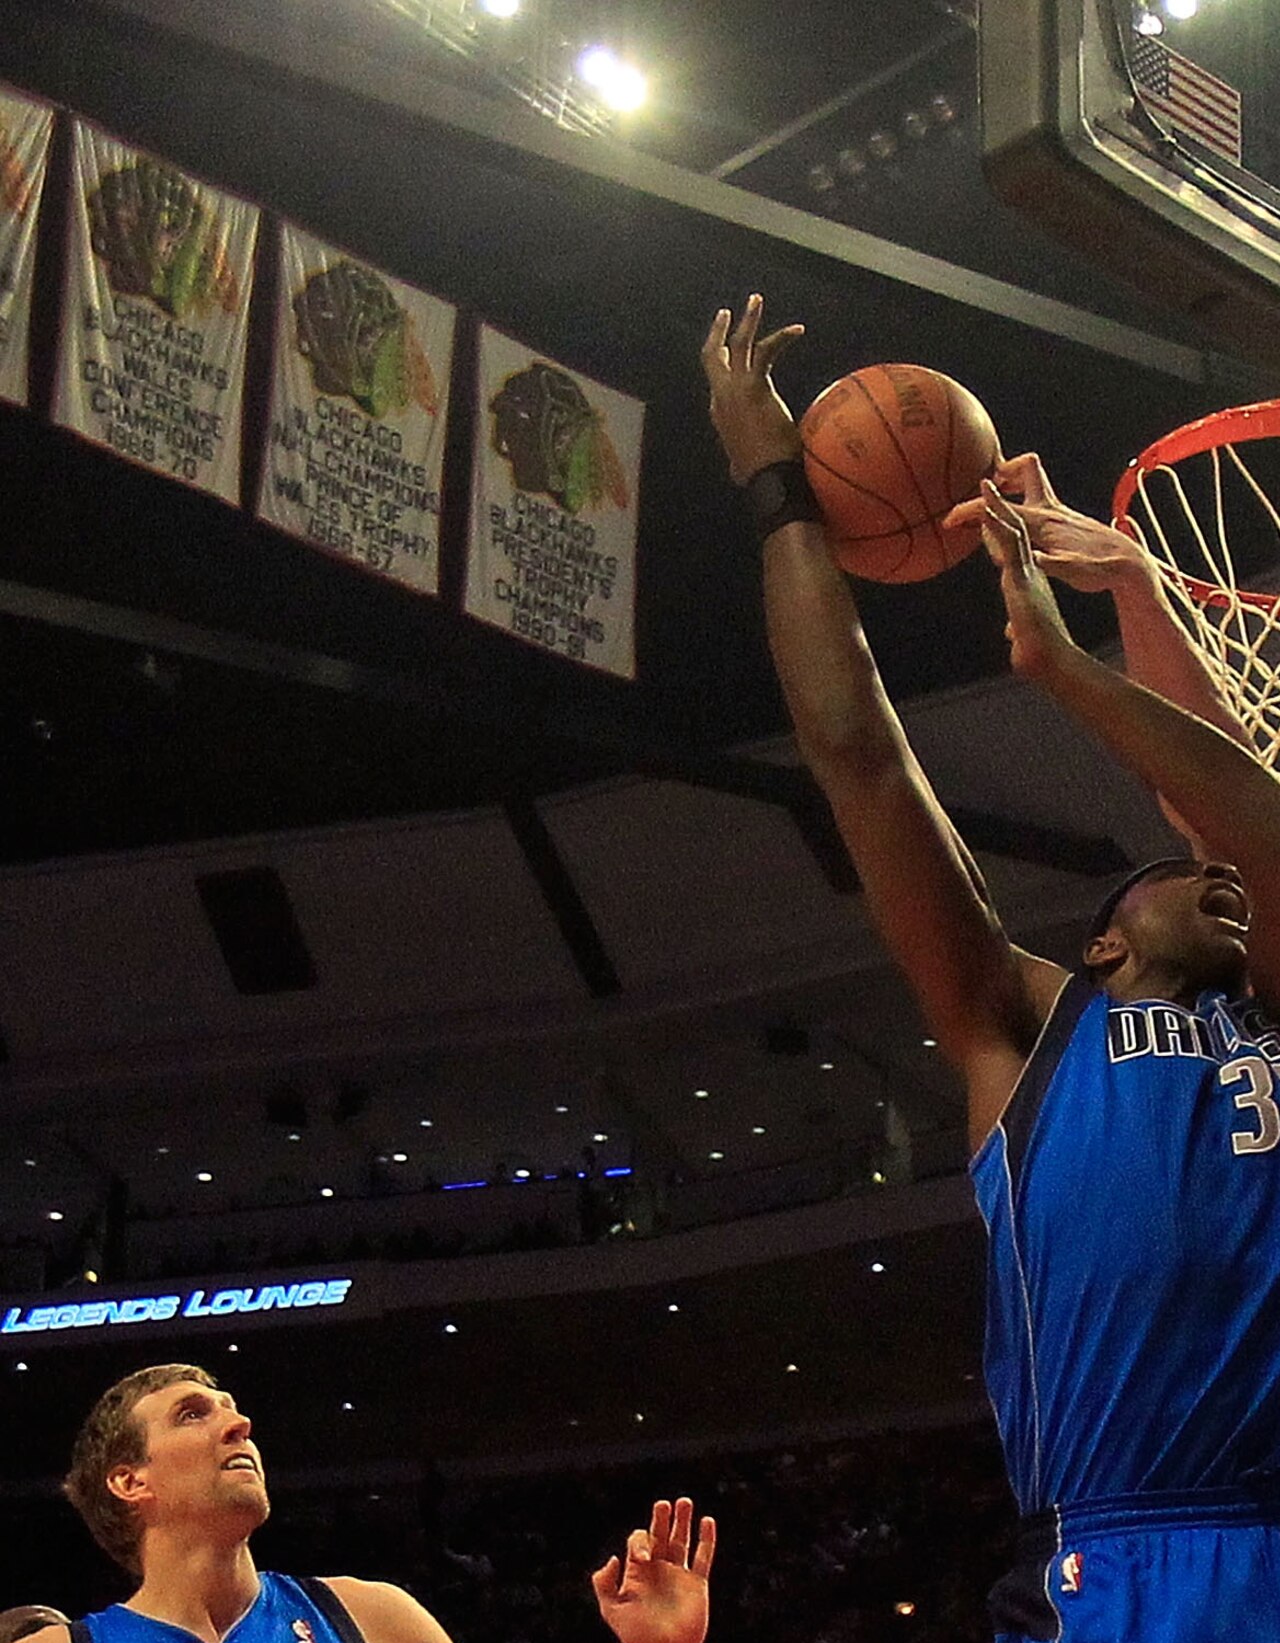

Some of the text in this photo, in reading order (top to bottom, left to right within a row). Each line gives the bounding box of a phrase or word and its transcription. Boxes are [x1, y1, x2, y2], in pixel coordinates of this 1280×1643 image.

[114, 299, 203, 355] CHICAGO
[84, 359, 222, 441] CONFERENCE
[122, 353, 193, 401] WALES
[91, 388, 213, 462] CHAMPIONS
[315, 396, 402, 453] CHICAGO
[306, 462, 402, 524] PRINCE OF
[325, 450, 440, 514] CHAMPIONS
[351, 513, 431, 556] TROPHY
[490, 504, 619, 578] BLACKHAWKS
[514, 492, 596, 547] CHICAGO
[494, 578, 605, 644] CHAMPIONS
[511, 562, 590, 612] TROPHY
[1, 1279, 352, 1334] LEGENDS LOUNGE
